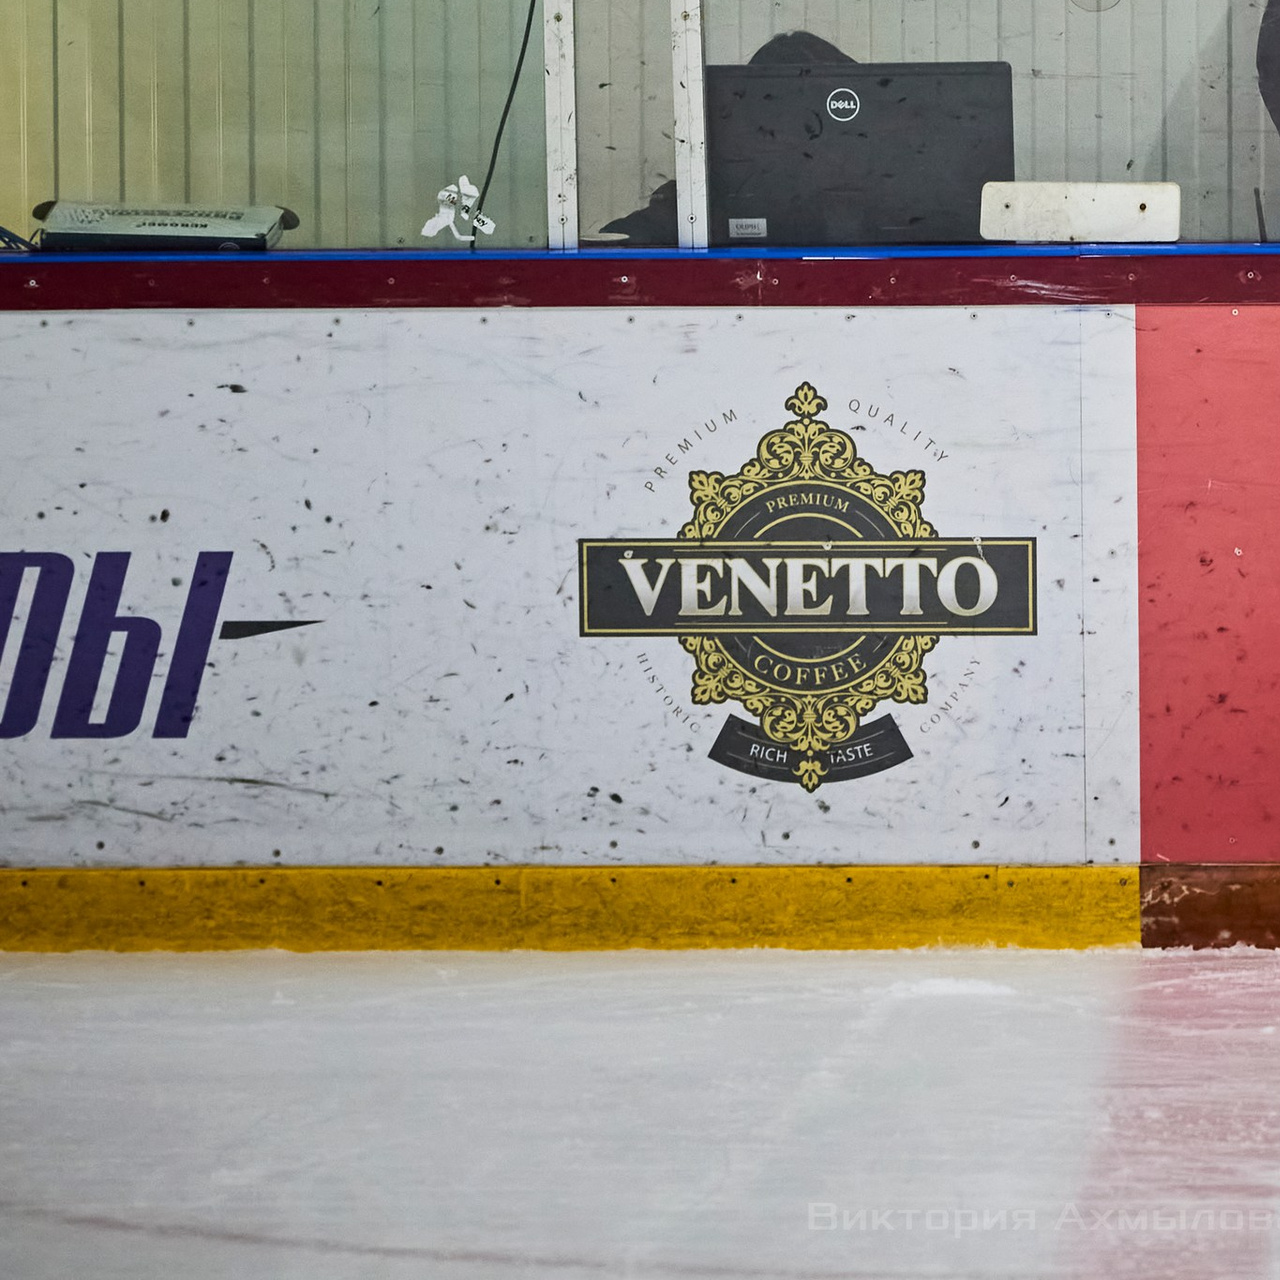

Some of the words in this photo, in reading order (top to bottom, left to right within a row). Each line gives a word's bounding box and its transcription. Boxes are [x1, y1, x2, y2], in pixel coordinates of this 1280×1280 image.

[830, 100, 857, 110] DELL
[644, 407, 738, 493] PREMIUM
[848, 398, 949, 463] QUALITY
[765, 492, 851, 514] PREMIUM
[618, 556, 999, 618] VENETTO
[753, 652, 868, 686] COFFEE
[636, 652, 702, 734] HISTORIC
[919, 656, 981, 734] COMPANY
[748, 742, 788, 764] RICH
[827, 742, 874, 764] TASTE
